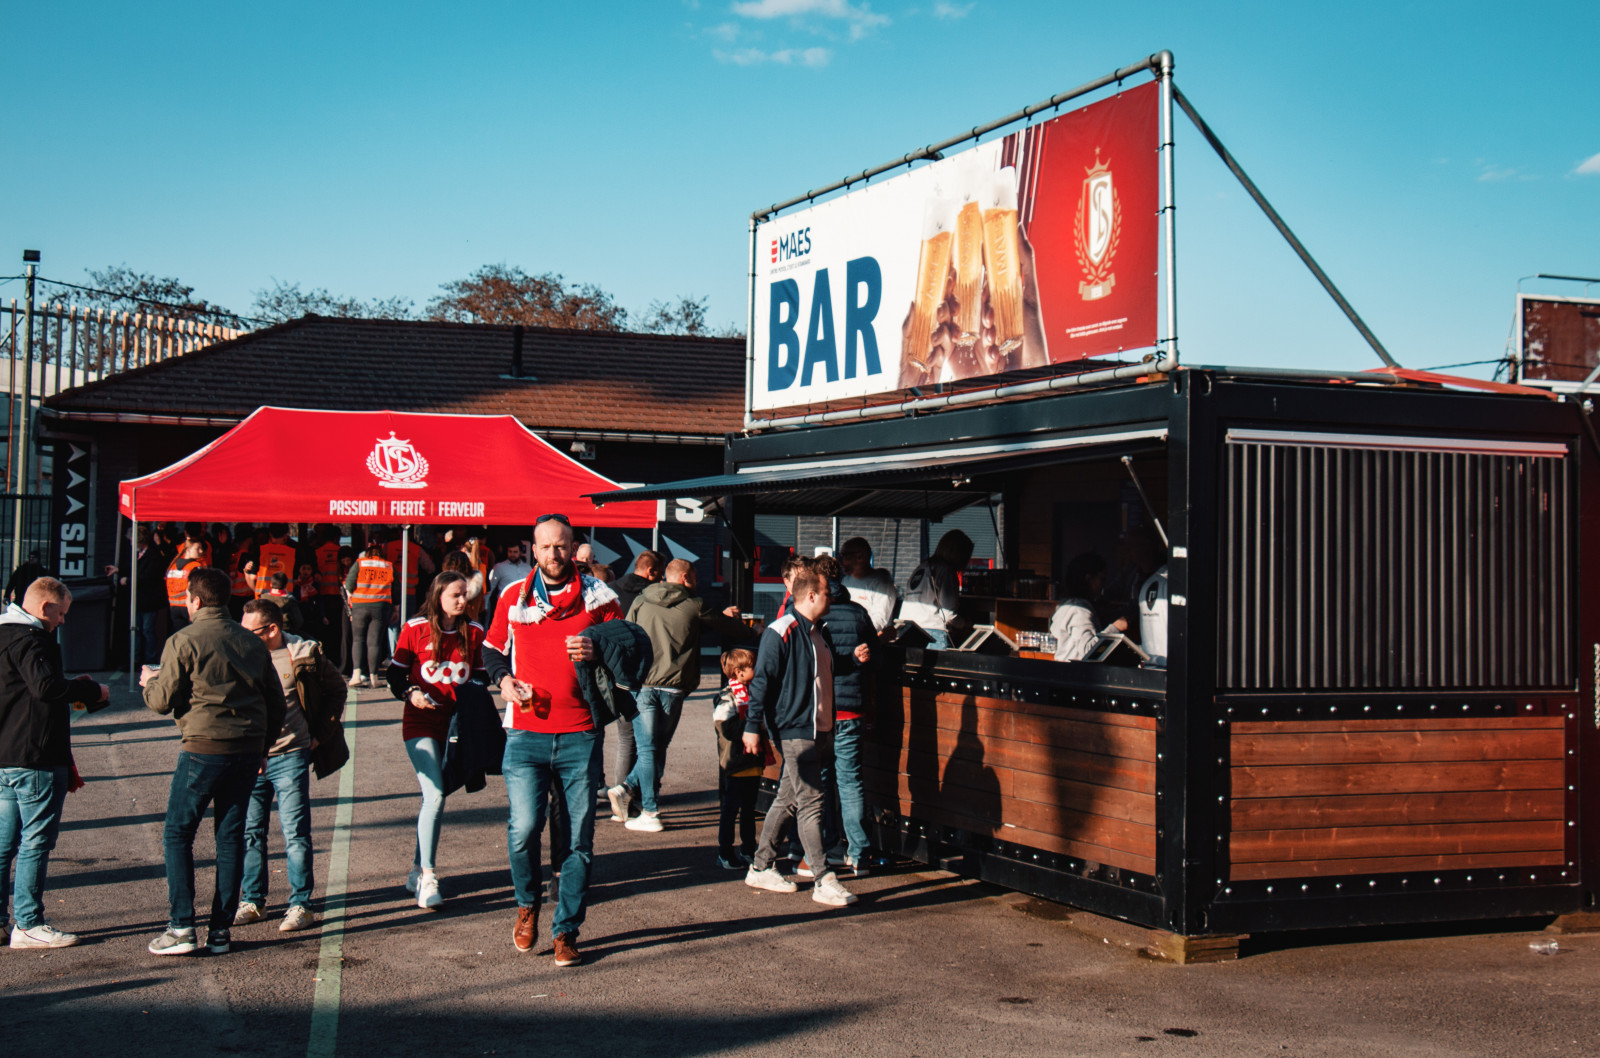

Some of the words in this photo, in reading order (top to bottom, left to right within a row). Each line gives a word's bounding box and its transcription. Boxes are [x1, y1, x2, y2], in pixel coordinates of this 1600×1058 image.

[779, 227, 811, 262] MAES
[768, 256, 882, 392] BAR
[329, 500, 377, 516] PASSION
[390, 500, 425, 517] FIERTÉ
[438, 502, 485, 517] FERVEUR
